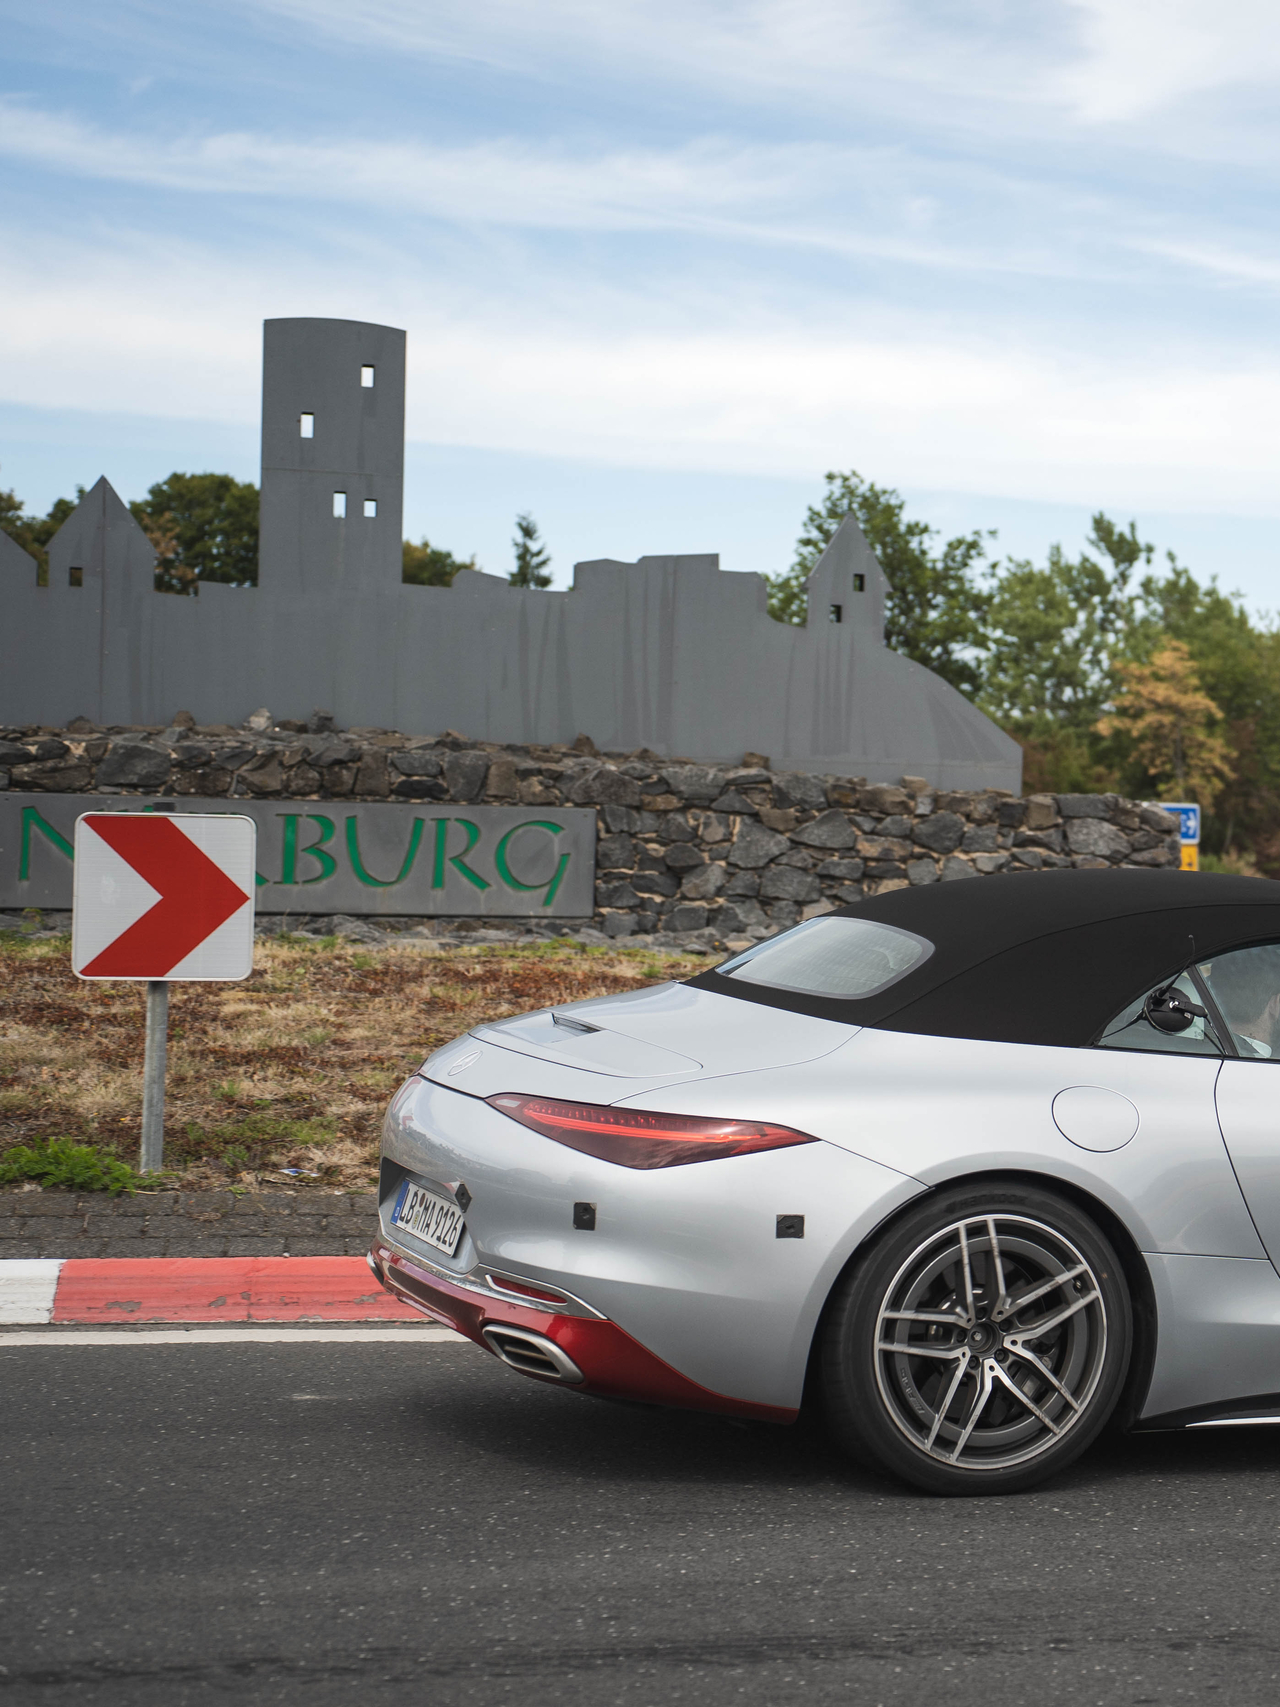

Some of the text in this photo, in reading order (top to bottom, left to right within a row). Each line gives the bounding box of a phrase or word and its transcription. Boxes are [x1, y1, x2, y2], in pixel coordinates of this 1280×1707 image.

[19, 805, 571, 907] NBURG
[399, 1188, 462, 1248] LB MA 9126
